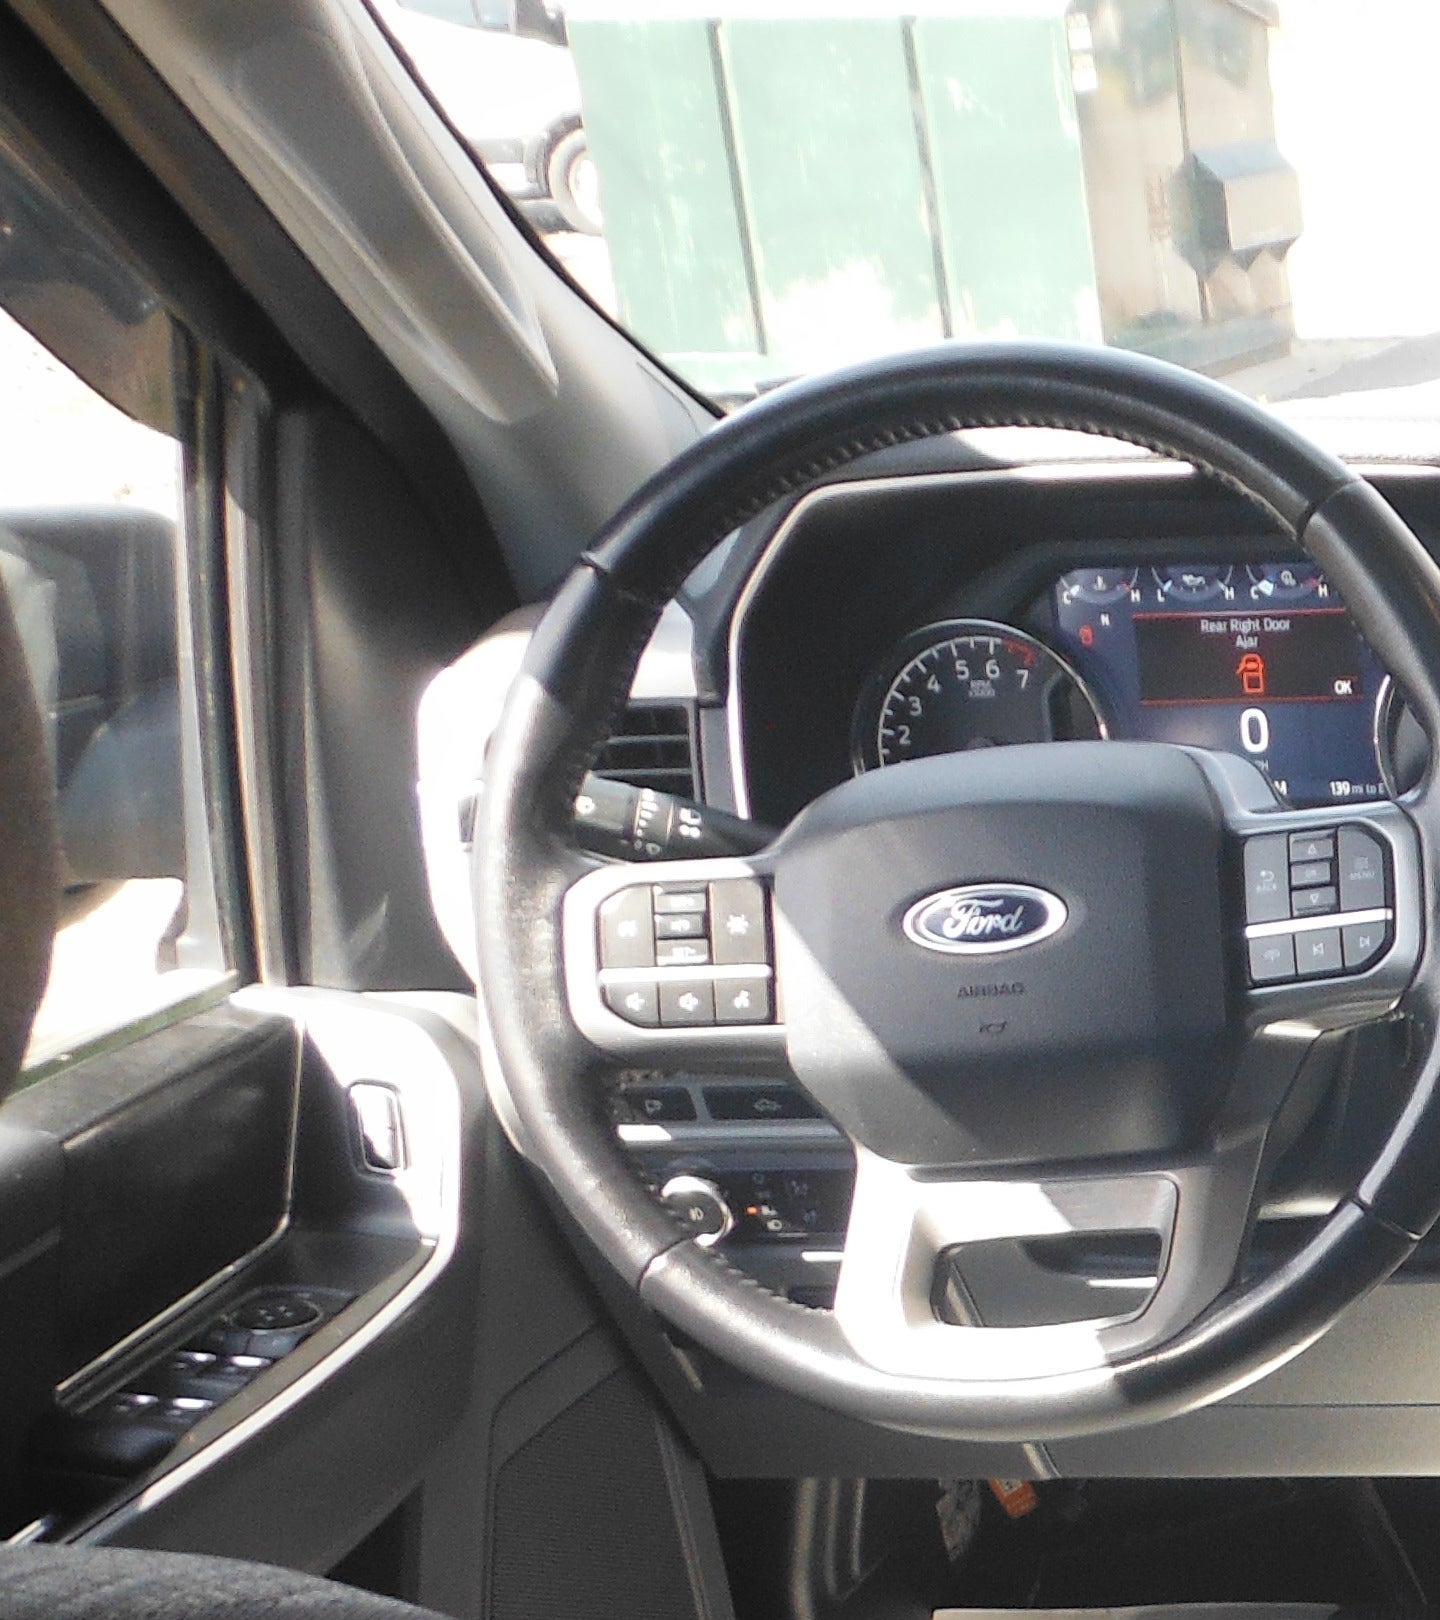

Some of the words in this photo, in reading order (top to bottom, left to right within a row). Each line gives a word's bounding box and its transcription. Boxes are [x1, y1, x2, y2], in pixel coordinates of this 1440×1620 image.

[1200, 619, 1228, 633] Rear
[1230, 618, 1261, 635] Right
[1264, 617, 1291, 631] Door
[1236, 635, 1259, 649] Ajar
[955, 660, 970, 679] 5
[985, 659, 1000, 679] 6
[1016, 669, 1029, 689] 7
[927, 674, 941, 693] 4
[1334, 680, 1352, 695] OK
[908, 696, 922, 716] 3
[898, 725, 912, 745] 2
[1240, 706, 1270, 753] 0
[942, 899, 1024, 939] Ford
